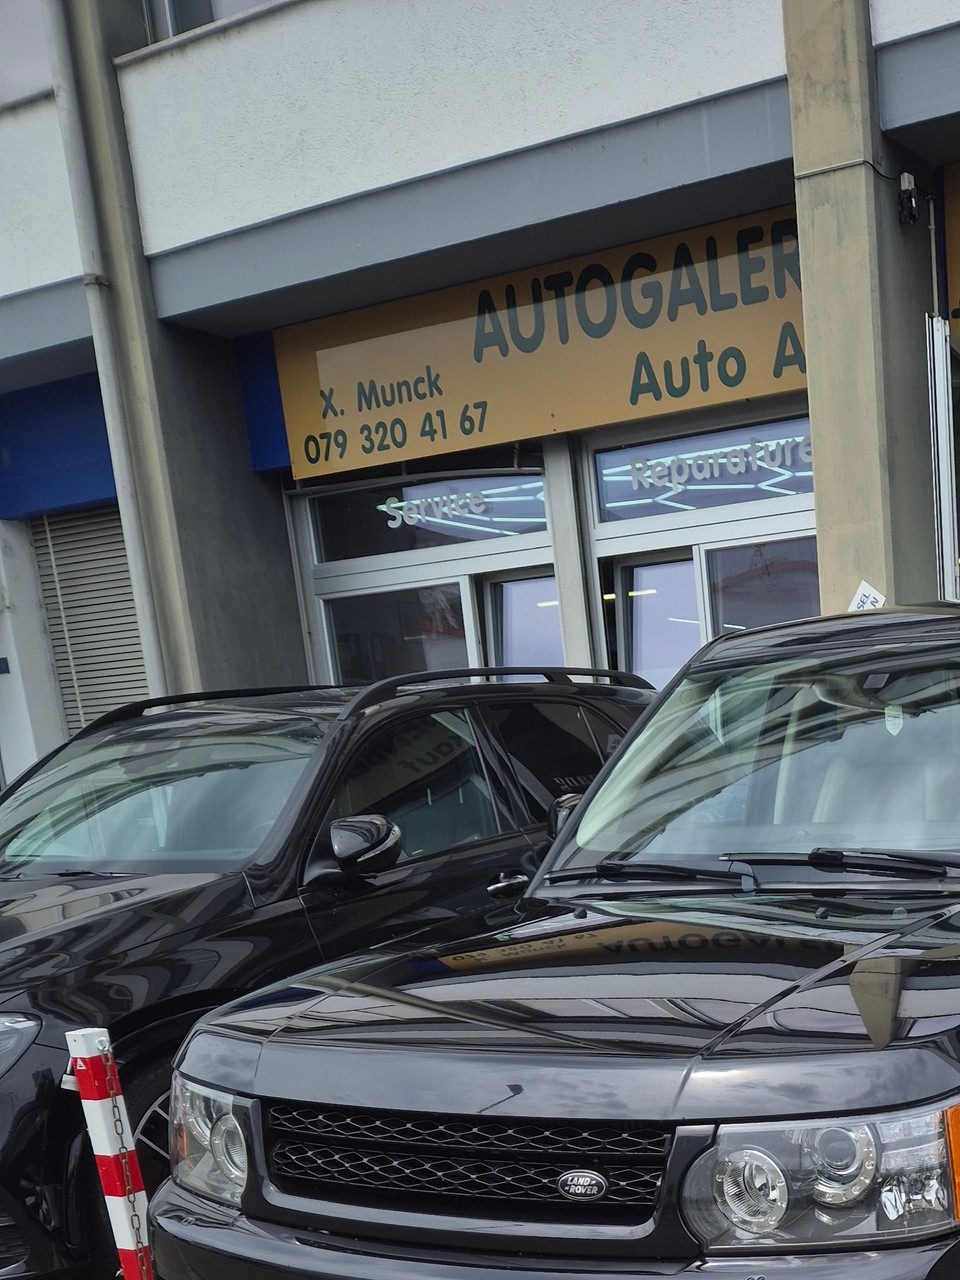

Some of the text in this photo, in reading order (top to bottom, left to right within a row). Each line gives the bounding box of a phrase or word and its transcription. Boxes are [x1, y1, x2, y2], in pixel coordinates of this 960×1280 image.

[472, 218, 802, 364] AUTOGALER
[319, 364, 443, 420] X. Munck
[629, 339, 747, 406] Auto
[303, 400, 488, 465] 079 320 41 67
[385, 486, 486, 529] Service
[567, 1177, 591, 1186] LAND
[569, 1185, 598, 1194] ROVER
